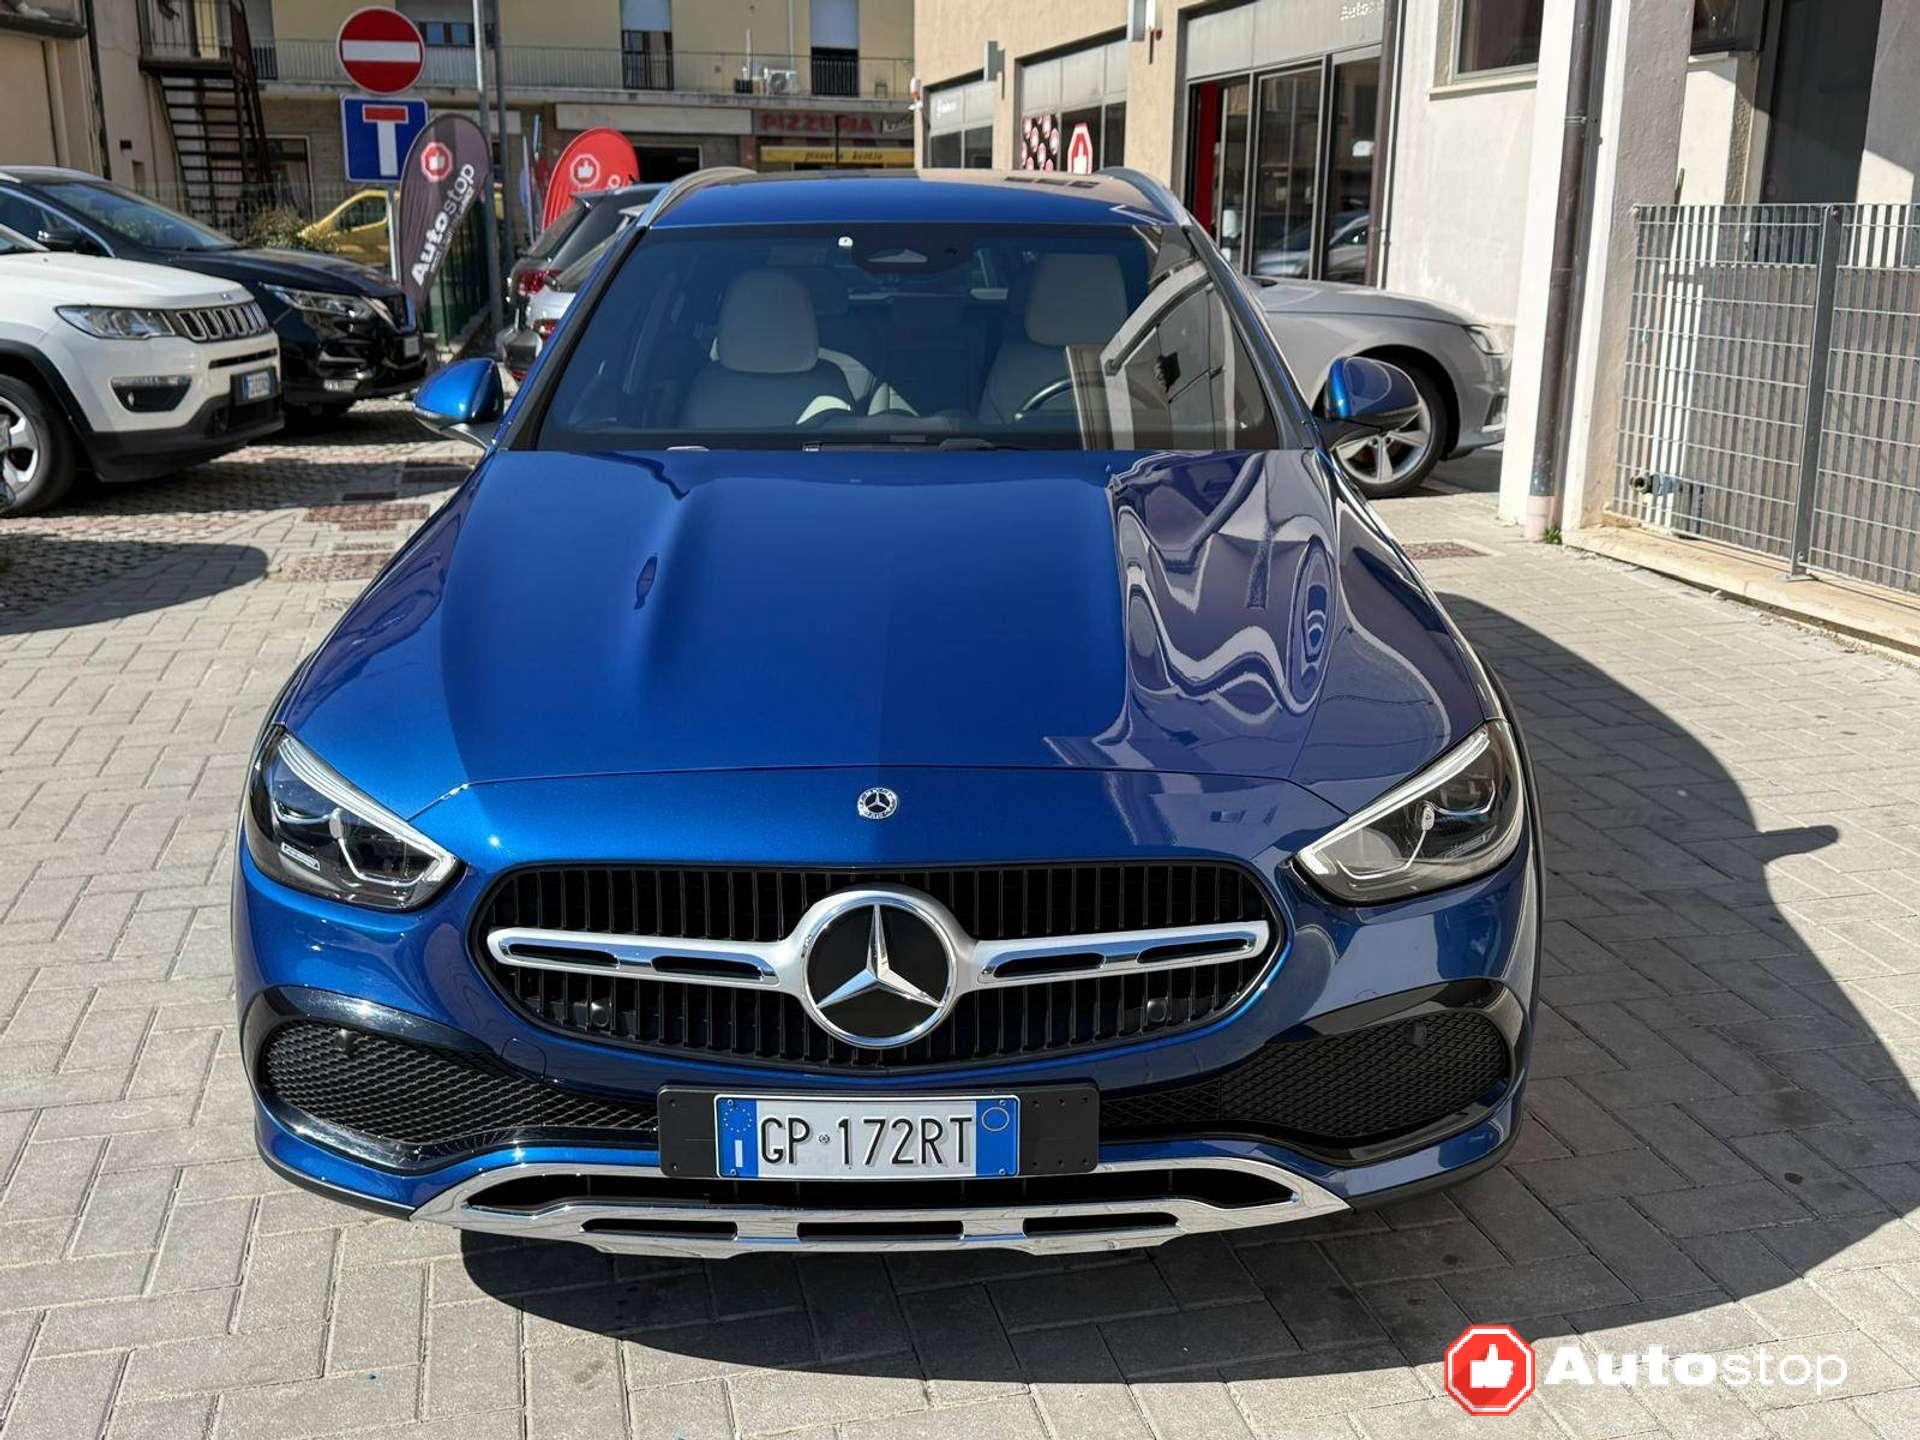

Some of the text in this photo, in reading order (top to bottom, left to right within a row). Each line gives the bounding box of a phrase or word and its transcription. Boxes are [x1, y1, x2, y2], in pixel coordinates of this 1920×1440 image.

[761, 112, 873, 133] PIZZERIA
[411, 163, 475, 287] Autostop
[760, 1115, 973, 1167] GP 172RT
